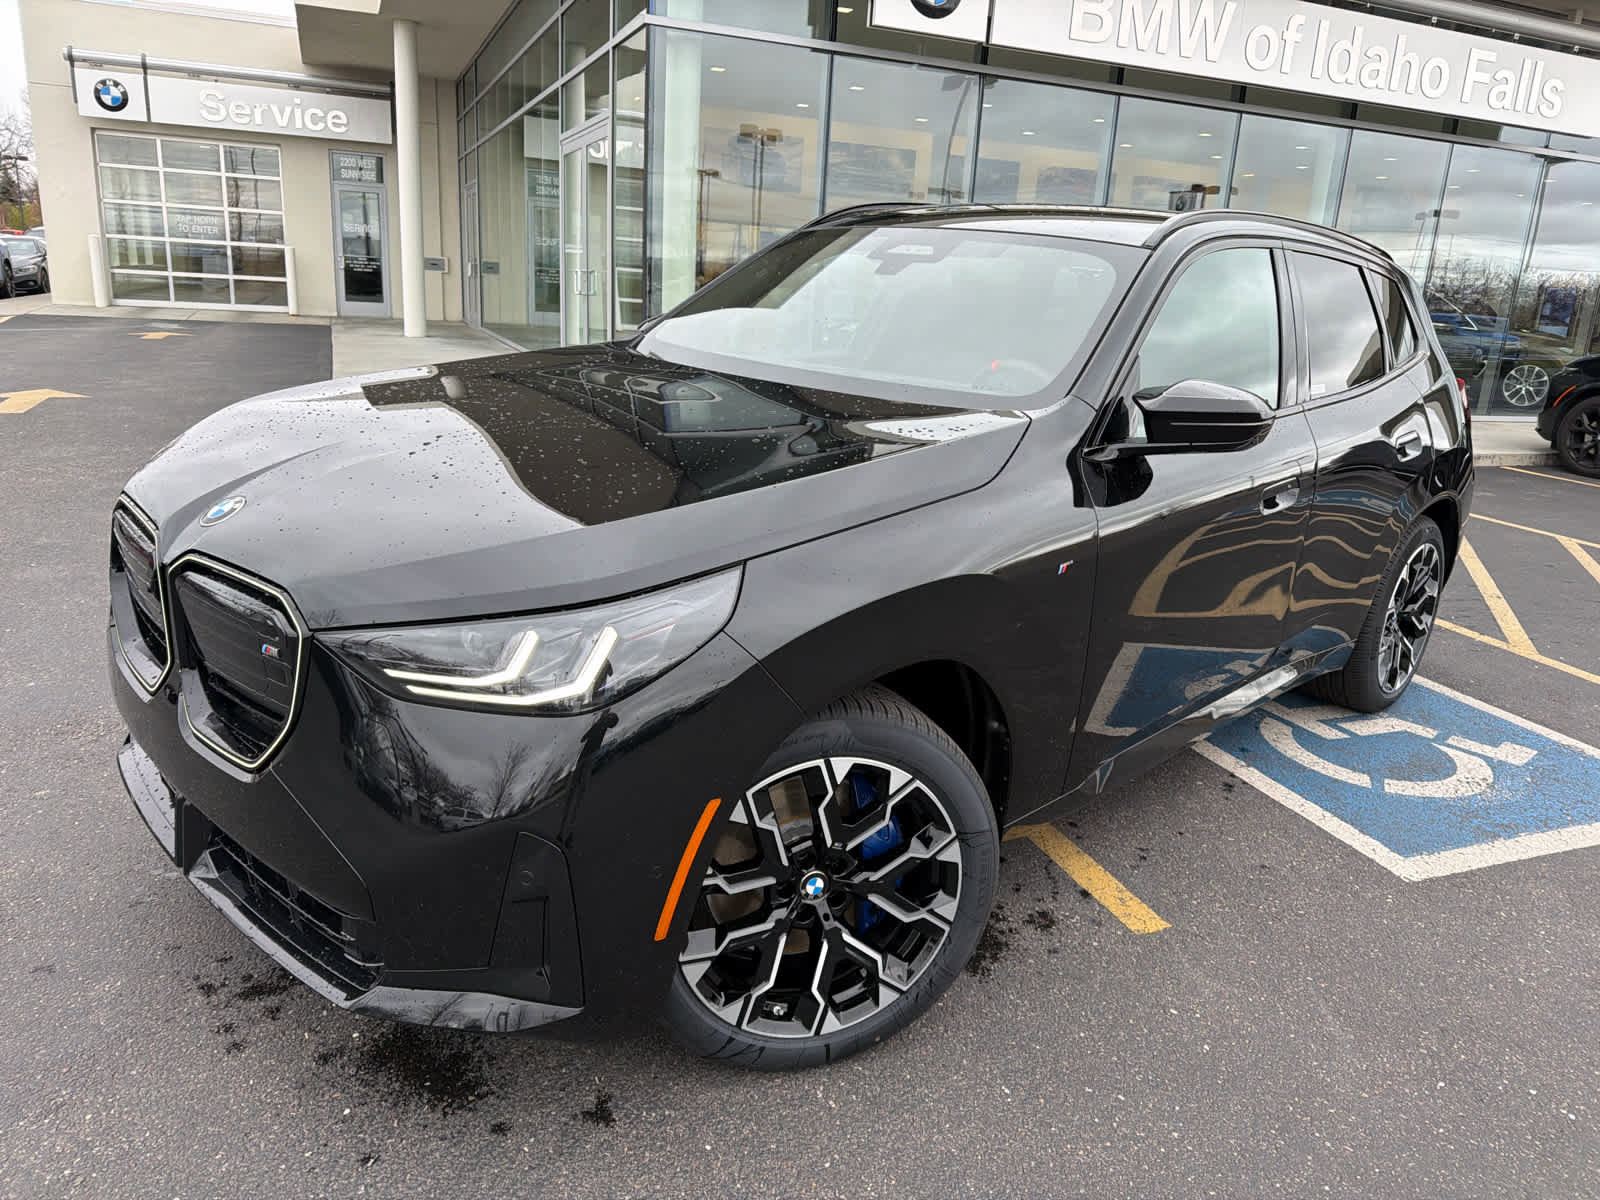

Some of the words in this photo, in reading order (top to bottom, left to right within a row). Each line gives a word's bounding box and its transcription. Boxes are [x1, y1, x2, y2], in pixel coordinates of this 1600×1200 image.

[1068, 0, 1238, 63] BMW
[1244, 14, 1306, 75] of
[1310, 16, 1451, 99] Idaho
[1460, 47, 1567, 119] Falls
[199, 88, 349, 133] Service
[191, 224, 218, 235] ENTER
